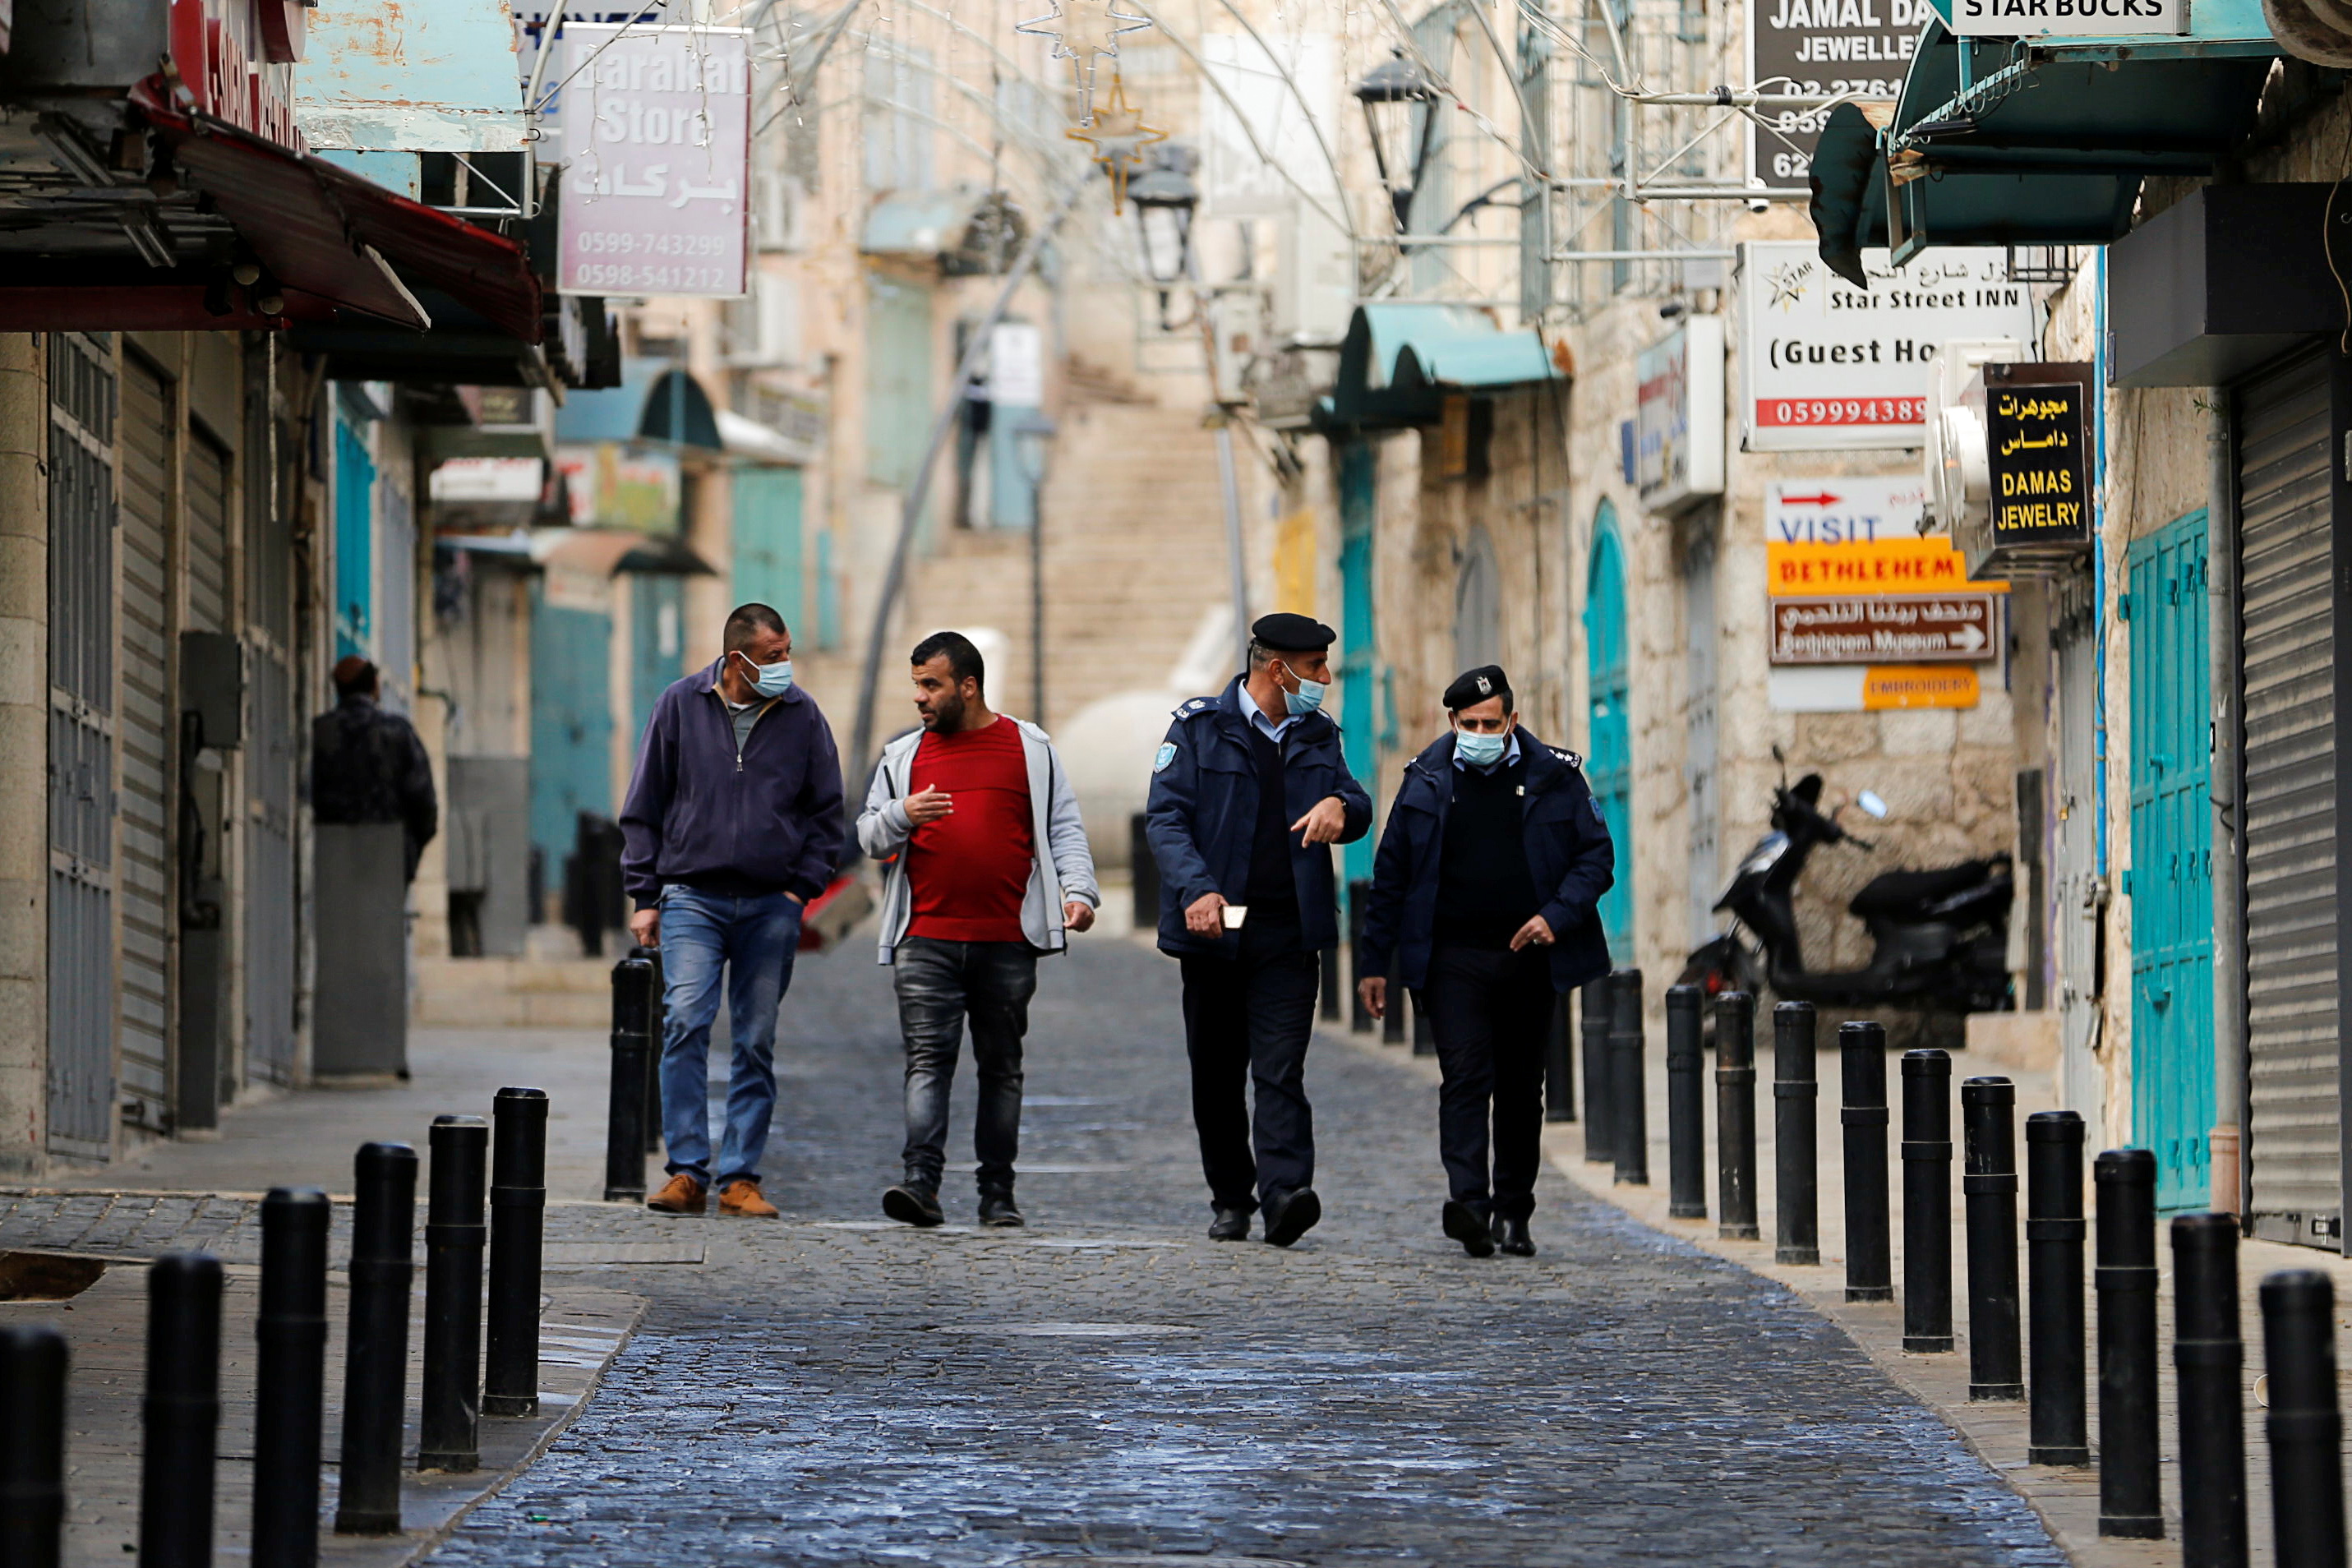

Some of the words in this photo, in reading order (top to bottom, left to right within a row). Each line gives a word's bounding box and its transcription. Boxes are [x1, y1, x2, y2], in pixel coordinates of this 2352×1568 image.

[1769, 0, 1882, 29] JAMAL
[1795, 35, 1918, 62] JEWELLE
[575, 44, 748, 95] Barakat
[598, 97, 715, 145] Store
[1773, 152, 1814, 178] 62
[574, 164, 738, 215] بركات
[578, 232, 725, 256] 0599-743299
[577, 264, 724, 288] 0598-541212
[1782, 261, 1815, 288] STAR
[1832, 290, 1880, 309] Star
[1890, 290, 1967, 309] Street
[1976, 289, 2019, 307] INN
[1770, 338, 1882, 369] (Guest
[1777, 400, 1927, 424] 059994389
[1999, 394, 2068, 421] مجوهرات
[2001, 428, 2068, 455] داماس
[2001, 468, 2072, 496] DAMAS
[1997, 501, 2080, 530] JEWELRY
[1780, 517, 1880, 545] VISIT
[1781, 557, 1954, 582] BETHLEHEM
